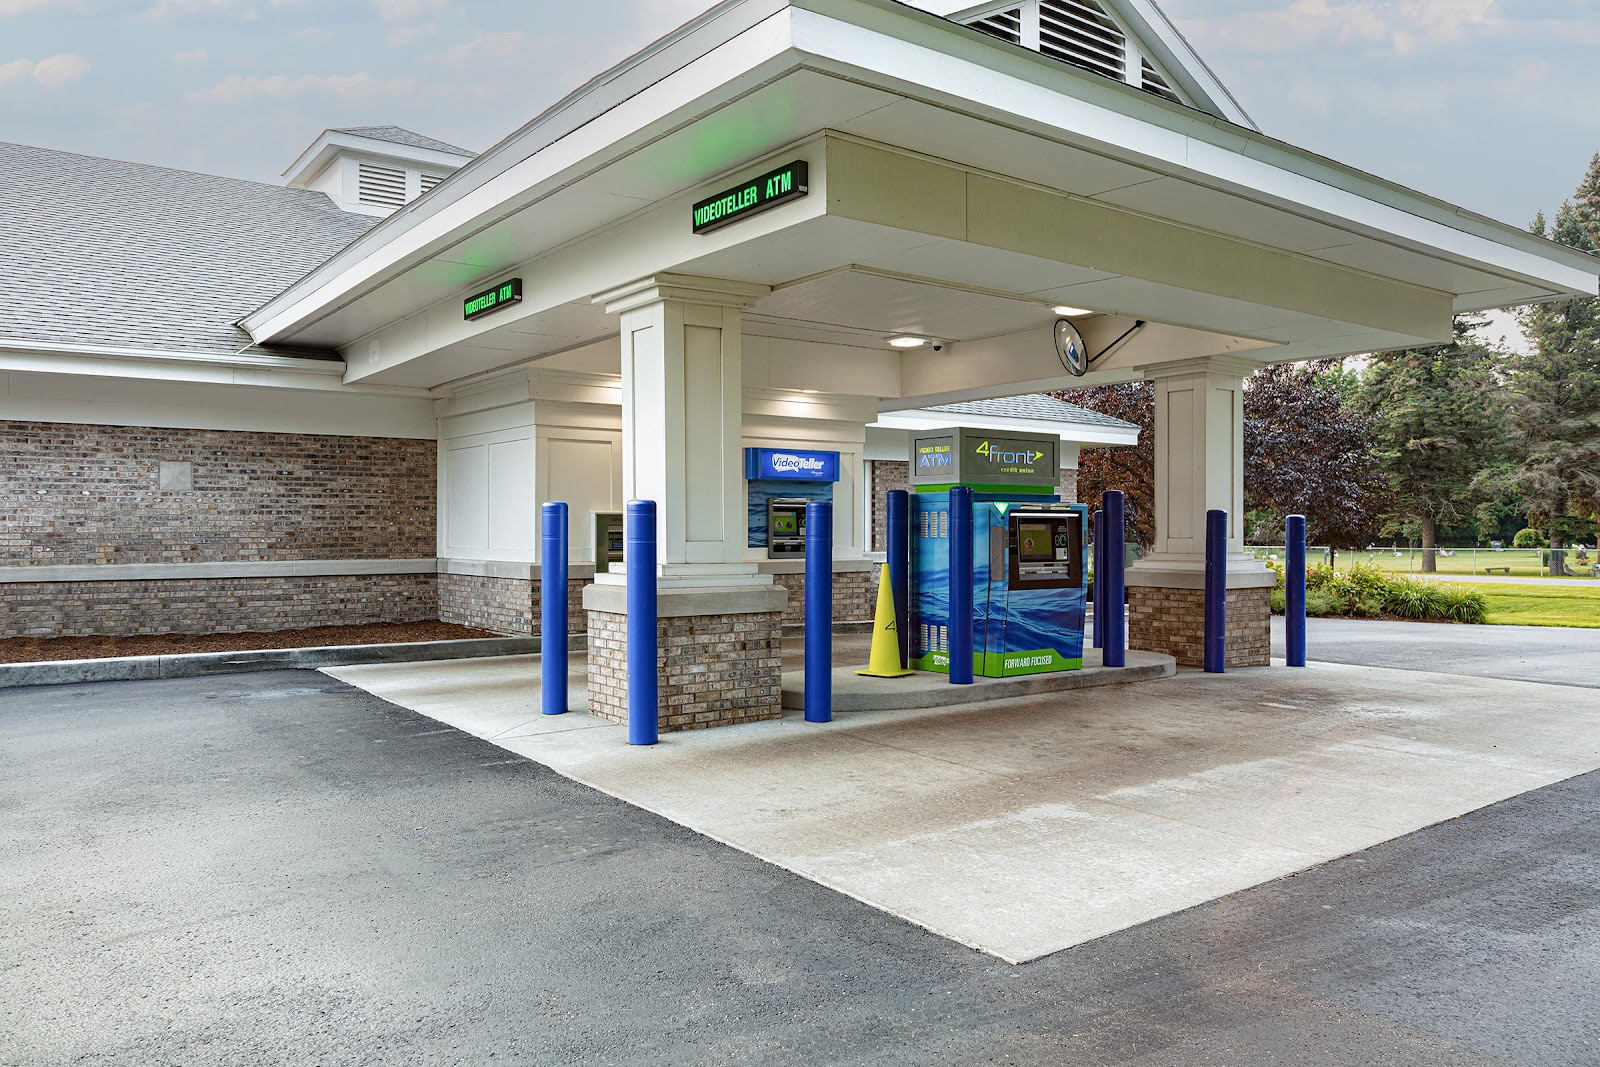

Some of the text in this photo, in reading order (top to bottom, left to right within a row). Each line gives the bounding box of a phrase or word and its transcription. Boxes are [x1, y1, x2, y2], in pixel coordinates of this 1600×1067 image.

[694, 170, 792, 227] VIDEOTELLER ATM
[465, 284, 512, 315] VIDEOTELLER ATM
[919, 445, 951, 454] VIDEO TELLER
[976, 440, 1036, 464] 4front
[918, 452, 952, 468] ATM
[1004, 654, 1053, 669] FORWARD FOCUSED
